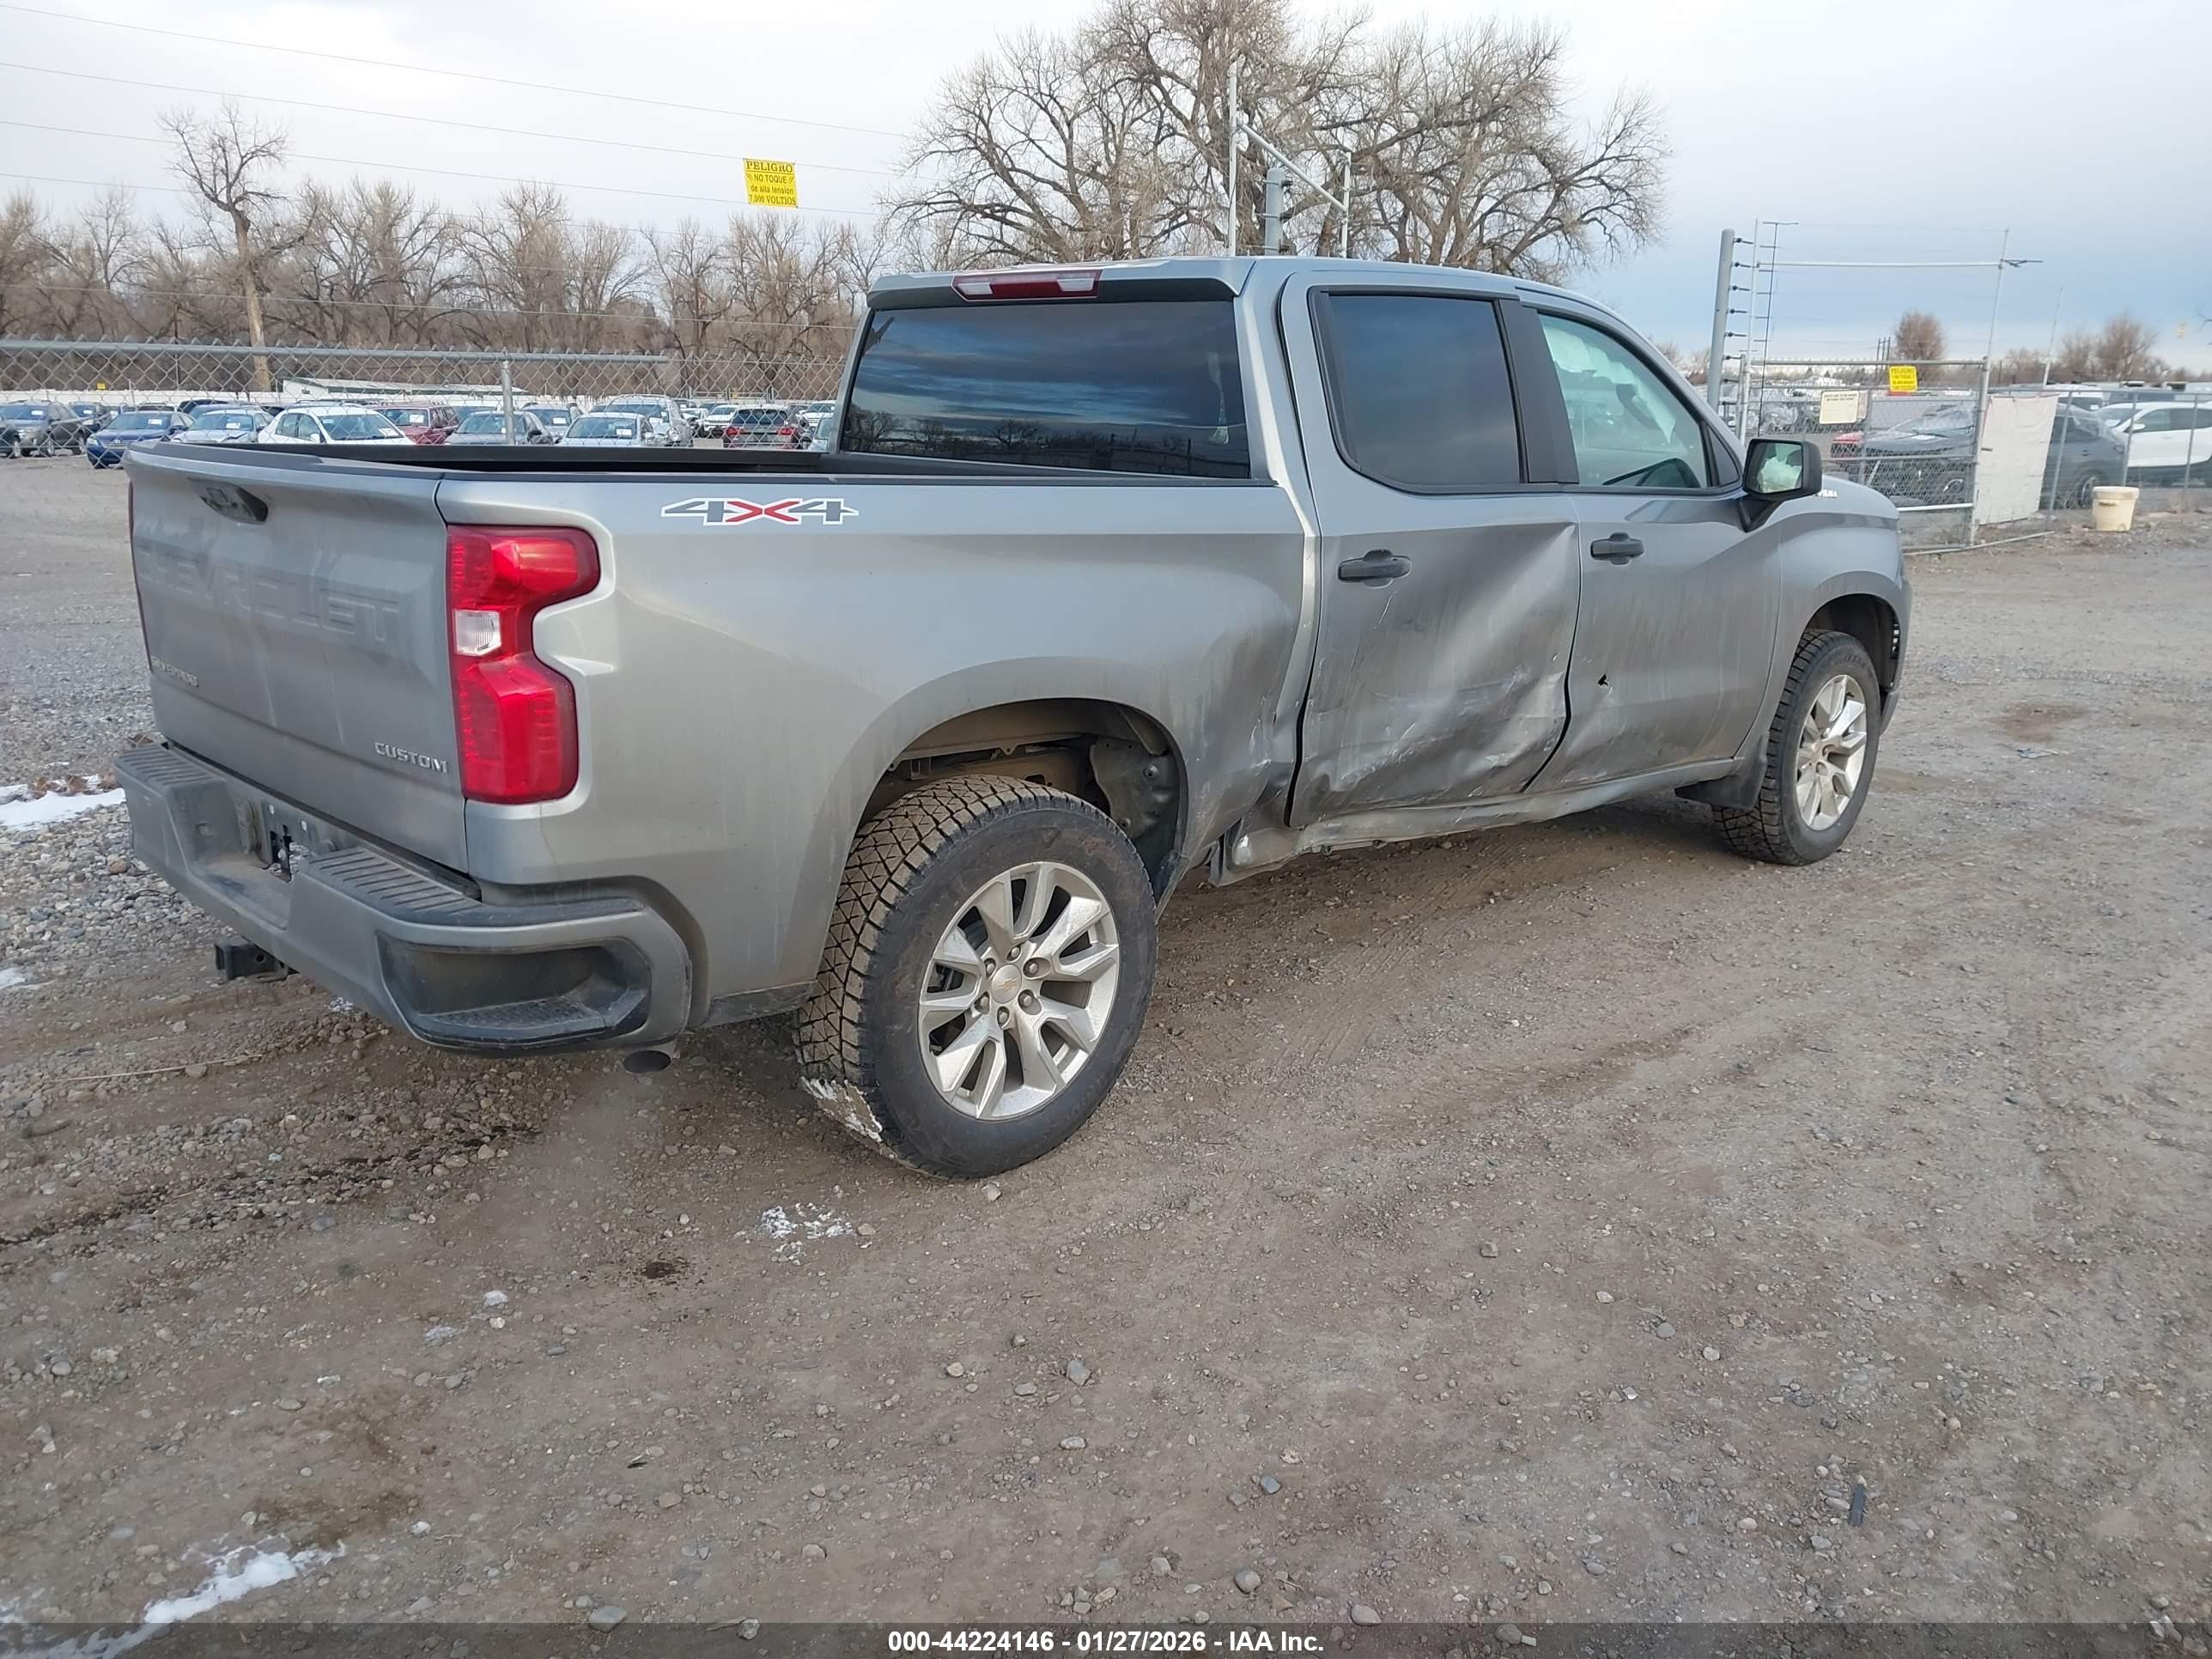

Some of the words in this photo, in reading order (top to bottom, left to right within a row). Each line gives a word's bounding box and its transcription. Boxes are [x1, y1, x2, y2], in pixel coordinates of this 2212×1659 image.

[746, 161, 793, 173] PELIGRO
[754, 173, 763, 183] NO
[765, 174, 787, 184] TOQUE
[766, 195, 797, 205] VOLTIOS
[131, 543, 399, 643] CHEVROLET
[374, 742, 447, 773] CUSTOM
